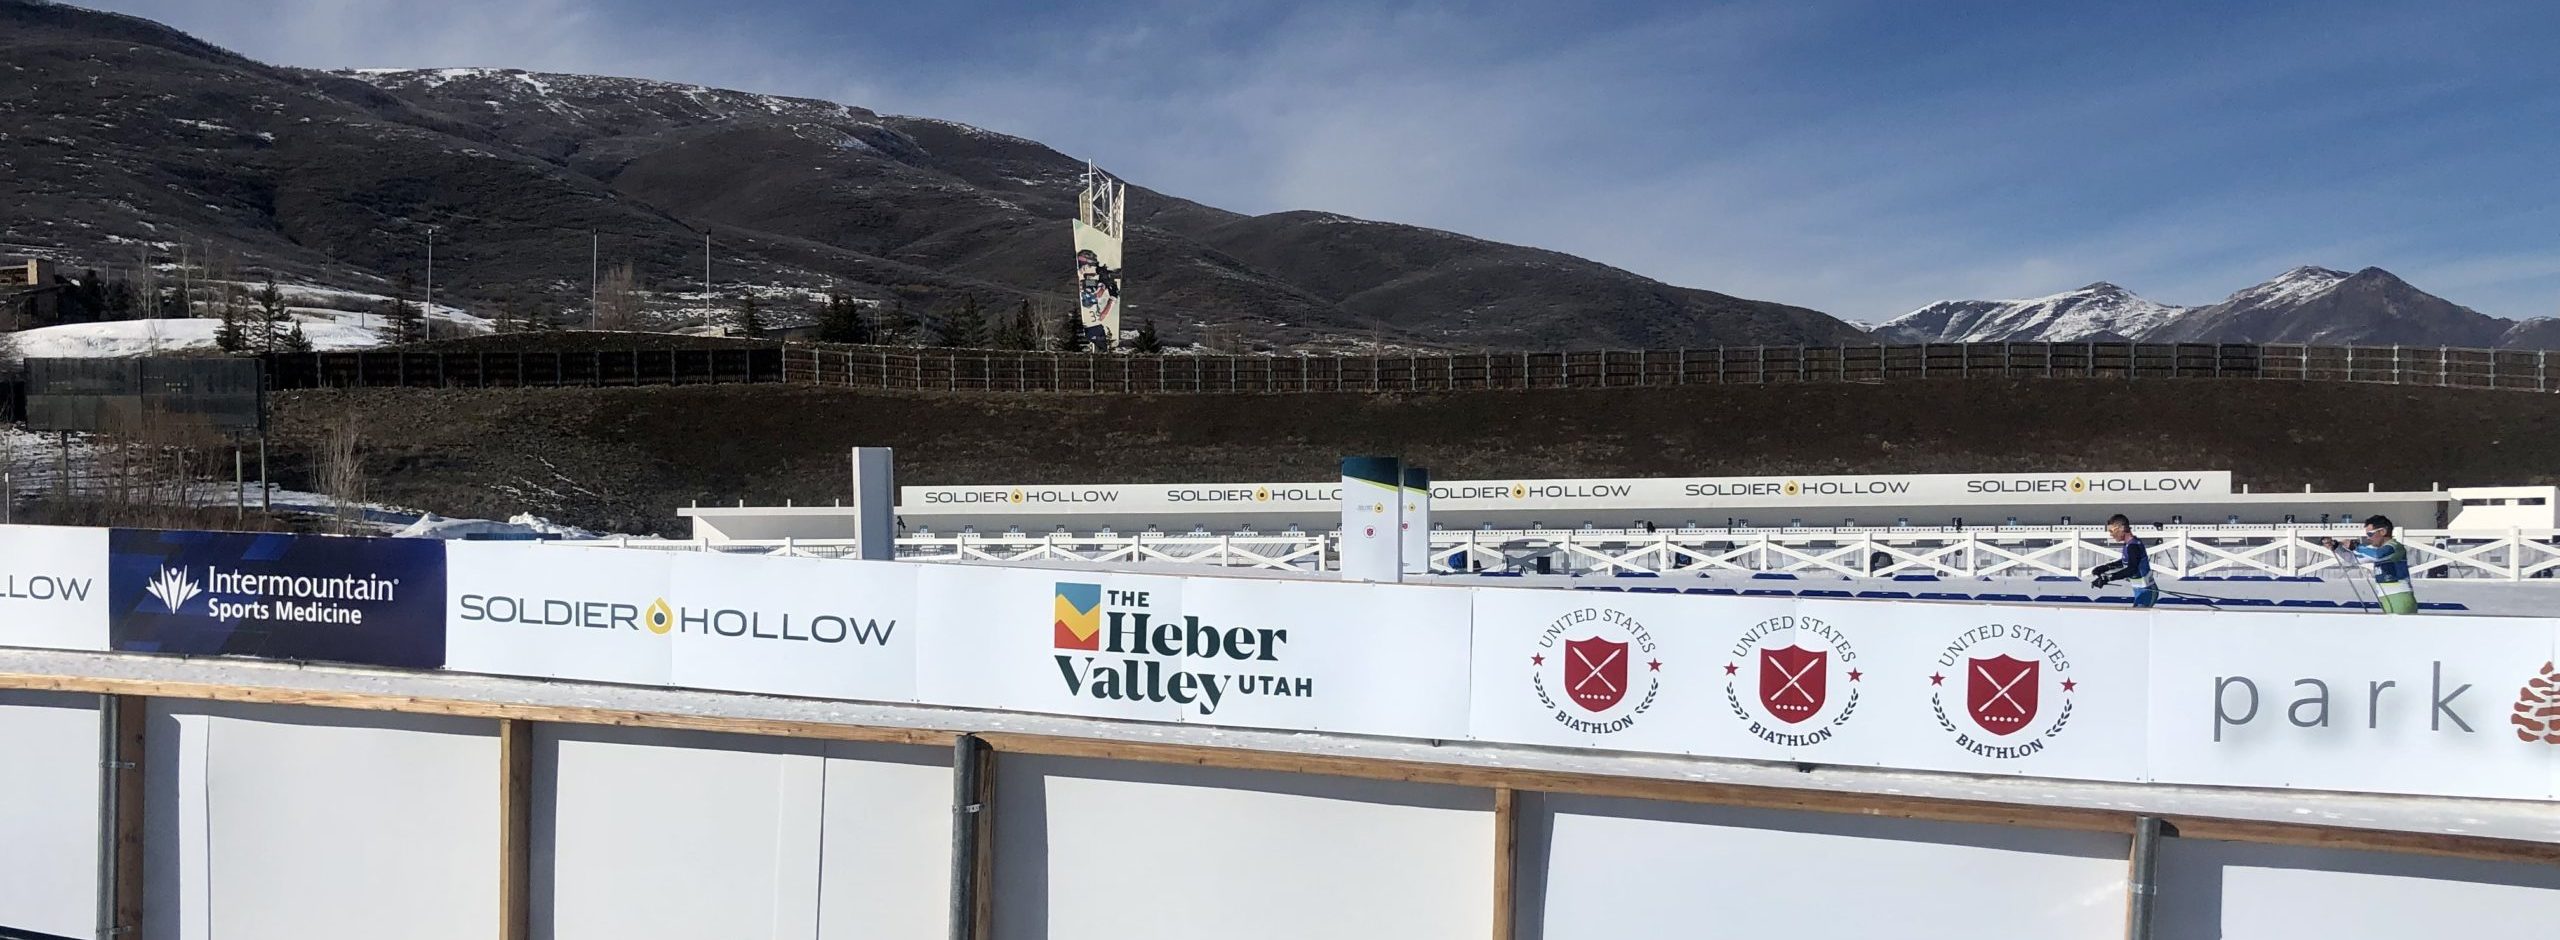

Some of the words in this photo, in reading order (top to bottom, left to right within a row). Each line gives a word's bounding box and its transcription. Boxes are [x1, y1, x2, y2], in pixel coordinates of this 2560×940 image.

[925, 491, 1009, 504] SOLDIER
[1025, 489, 1119, 504] HOLLOW
[1166, 488, 1254, 503] SOLDIER
[1271, 488, 1343, 502] HOLLO
[1428, 486, 1510, 500] OLDIER
[1528, 484, 1632, 498] HOLLOW
[1684, 483, 1781, 497] SOLDIER
[1801, 481, 1911, 495] HOLLOW
[1966, 479, 2068, 494] SOLDIER
[2088, 477, 2202, 492] HOLLOW
[208, 566, 395, 602] Intermountain
[208, 597, 270, 622] Sports
[275, 600, 362, 625] Medicine
[1108, 590, 1150, 607] THE
[460, 594, 640, 631] SOLDIER
[680, 607, 896, 646] HOLLOW
[1539, 608, 1598, 650] UNITED
[1602, 608, 1657, 655] STATES
[1106, 612, 1287, 661] Heber
[1731, 615, 1795, 659] UNITED
[1799, 615, 1857, 663] STATES
[1938, 623, 2006, 669] UNITED
[2010, 625, 2071, 674] STATES
[1054, 655, 1232, 715] Valley
[1238, 674, 1312, 698] UTAH
[2213, 661, 2475, 742] park
[1555, 712, 1634, 735] BIATHLON
[1748, 720, 1833, 747] BIATHLON
[1955, 732, 2045, 760] BIATHLON
